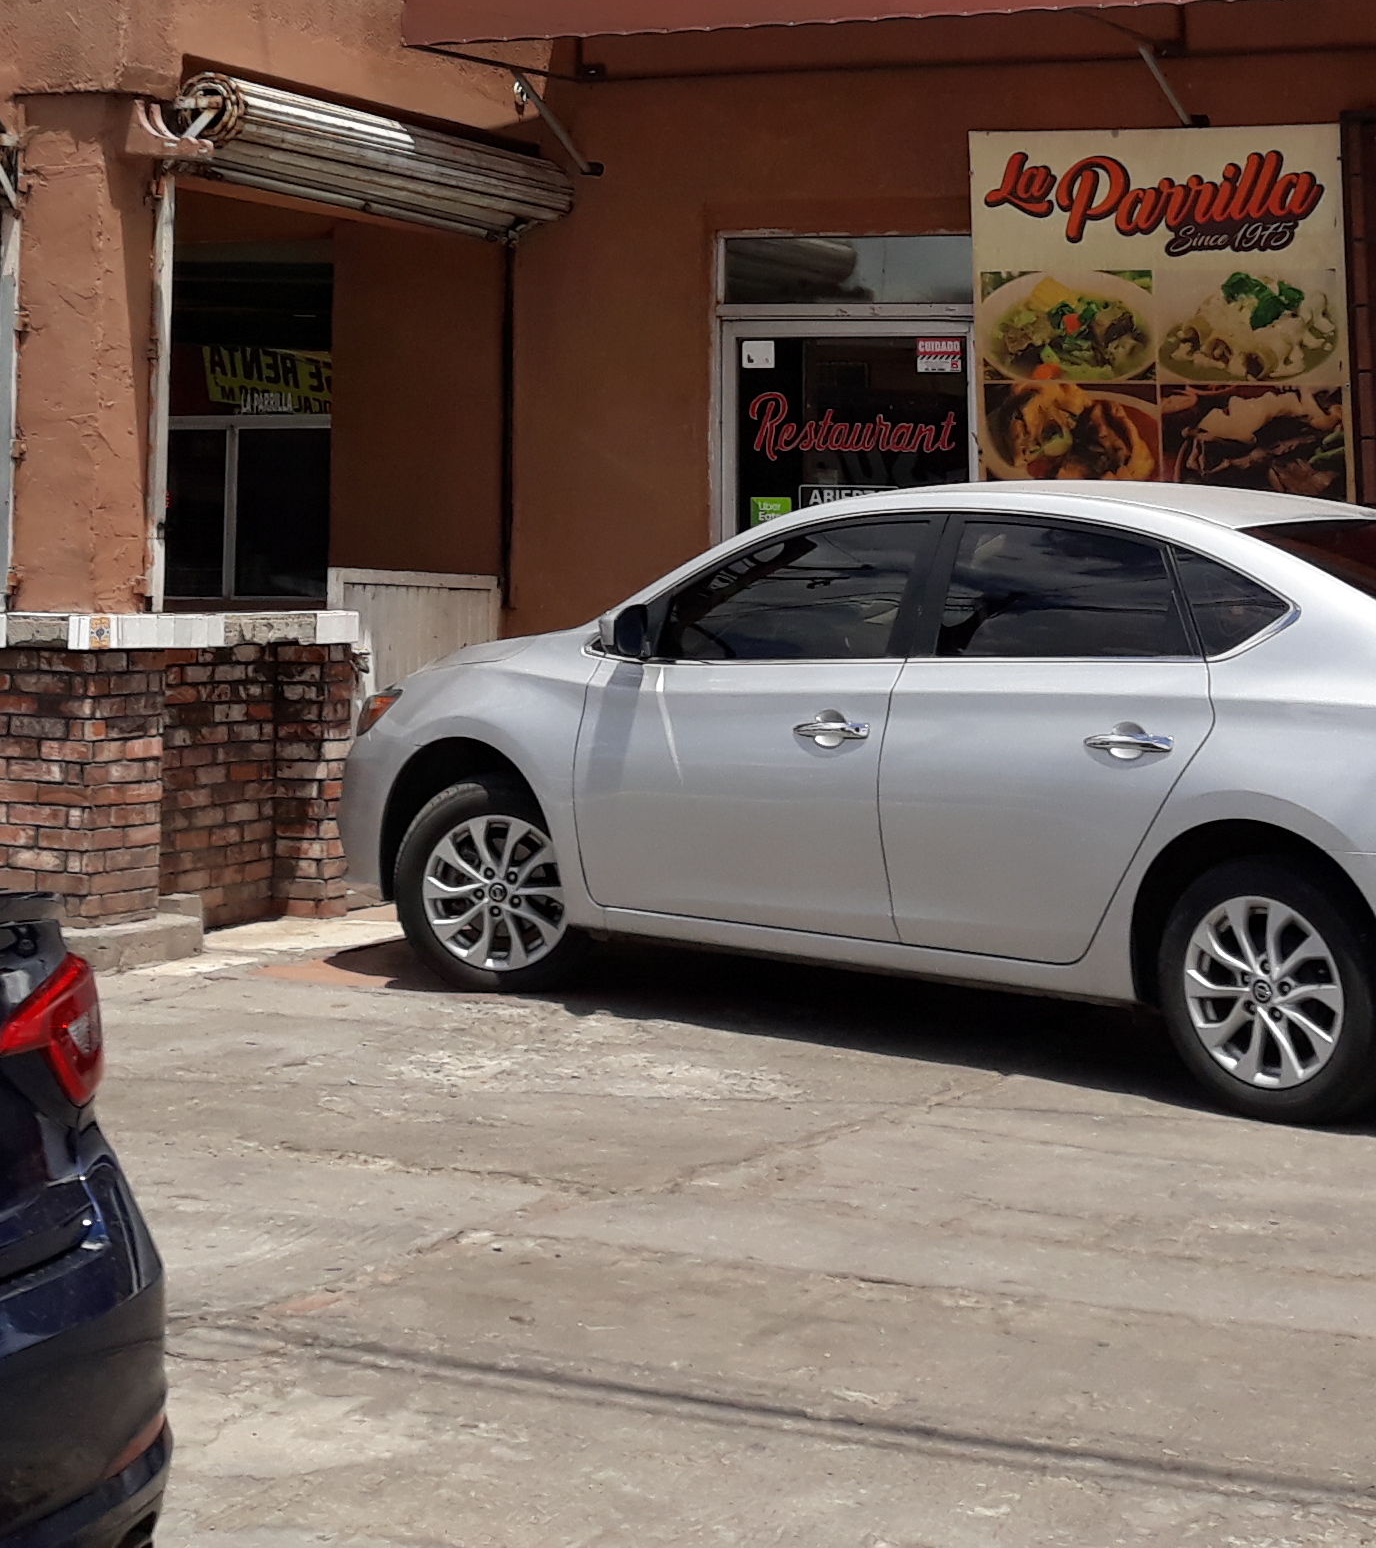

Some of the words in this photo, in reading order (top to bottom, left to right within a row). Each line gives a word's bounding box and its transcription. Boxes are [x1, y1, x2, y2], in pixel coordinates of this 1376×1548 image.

[985, 151, 1057, 219] La
[1055, 150, 1325, 243] Parrilla
[1169, 225, 1229, 253] Since
[1234, 221, 1296, 251] 1975
[918, 340, 961, 352] CUIDADO
[749, 391, 957, 461] Restaurant
[758, 501, 782, 512] Uber
